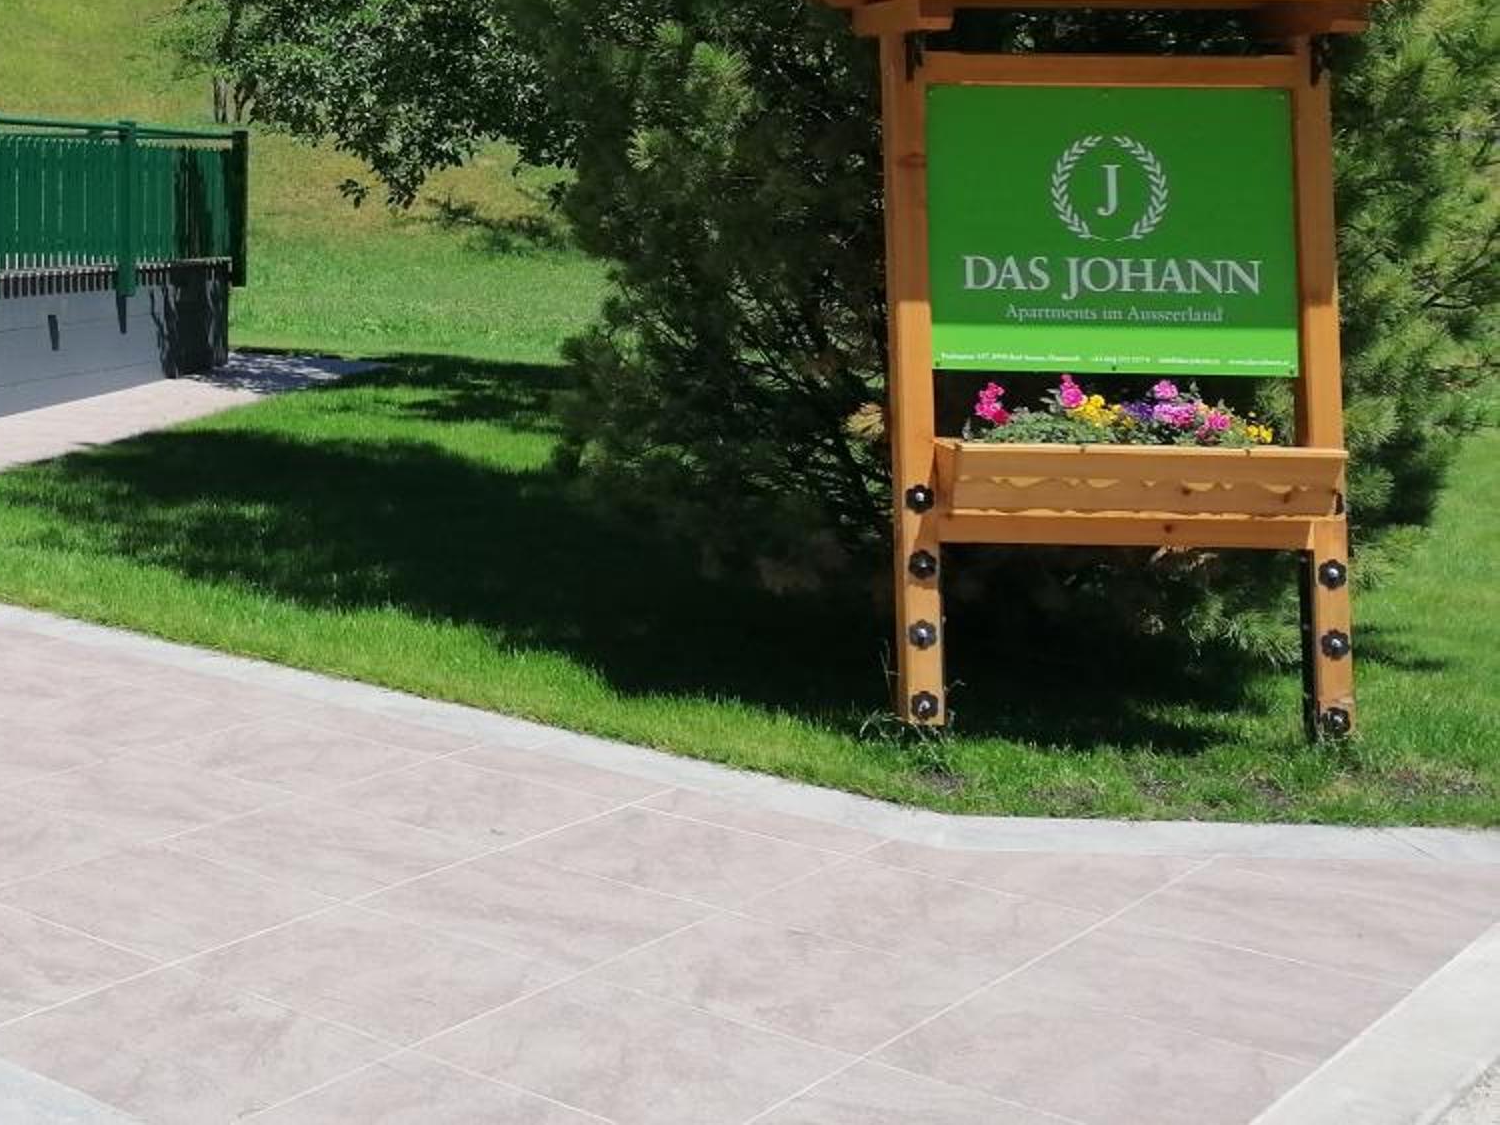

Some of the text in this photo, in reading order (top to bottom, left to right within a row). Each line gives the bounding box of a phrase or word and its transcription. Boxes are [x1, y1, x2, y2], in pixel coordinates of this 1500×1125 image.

[1097, 164, 1121, 216] J
[963, 255, 1262, 300] DAS JOHANN
[1005, 303, 1223, 323] Apartments im Ausseerland
